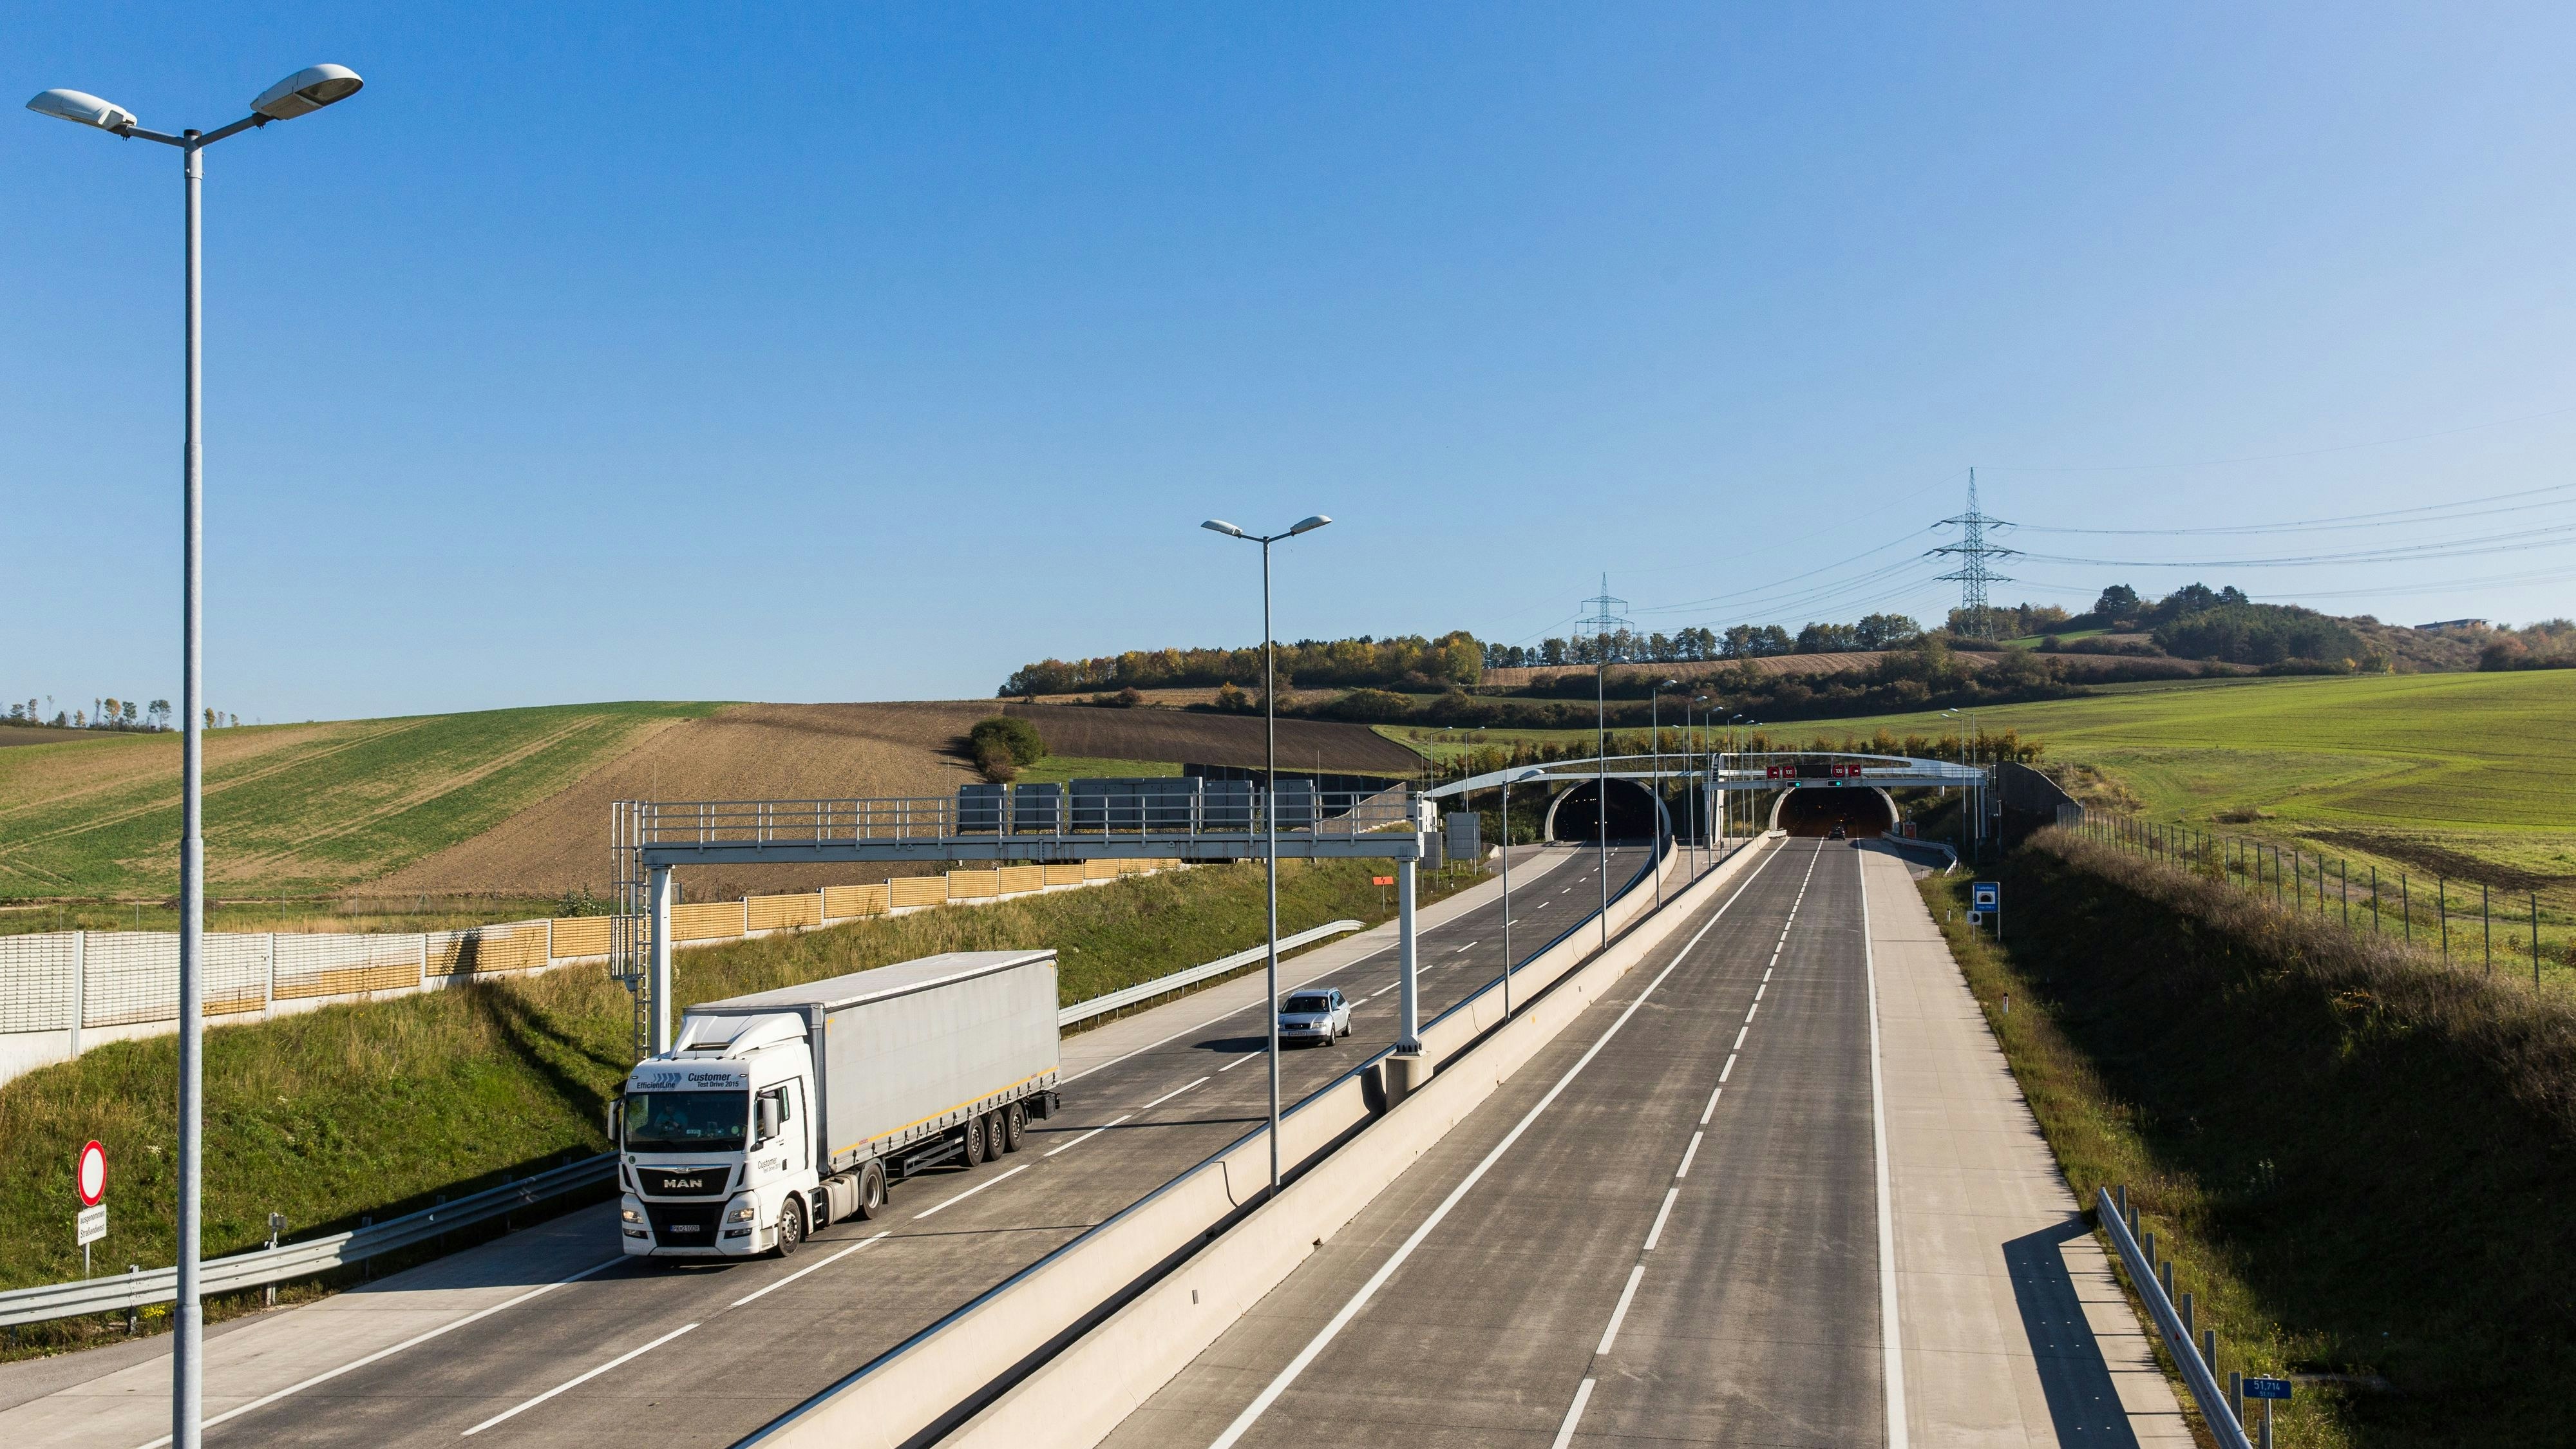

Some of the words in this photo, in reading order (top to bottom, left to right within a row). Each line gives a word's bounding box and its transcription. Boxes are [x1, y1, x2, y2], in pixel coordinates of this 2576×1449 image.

[688, 1072, 731, 1081] Customer
[757, 1157, 777, 1169] Customer
[664, 1179, 703, 1188] MAN
[80, 1210, 104, 1224] ausgenommen
[80, 1224, 104, 1238] Straßendienst
